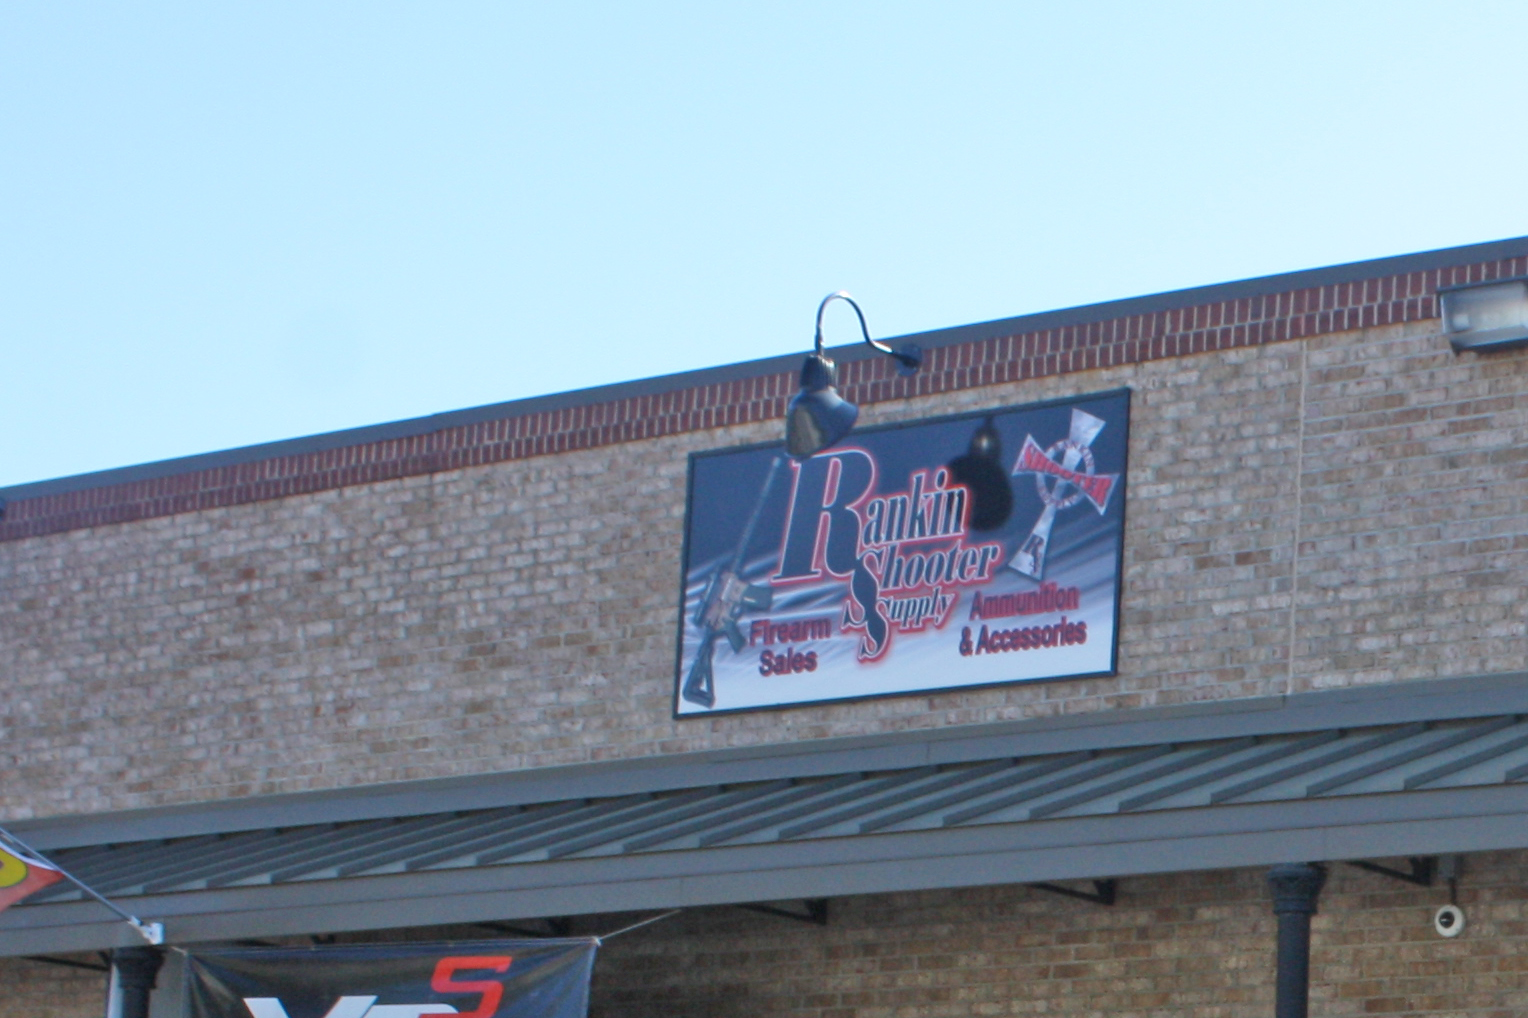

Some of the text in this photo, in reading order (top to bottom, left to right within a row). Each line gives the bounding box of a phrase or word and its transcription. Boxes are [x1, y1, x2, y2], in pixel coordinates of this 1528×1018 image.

[770, 448, 970, 585] Rankin
[842, 540, 1002, 630] Shooter
[969, 581, 1081, 621] Ammunition
[749, 617, 832, 647] Firearm
[858, 588, 956, 662] Supply
[959, 615, 1087, 657] & Accessories
[759, 647, 818, 677] Sales
